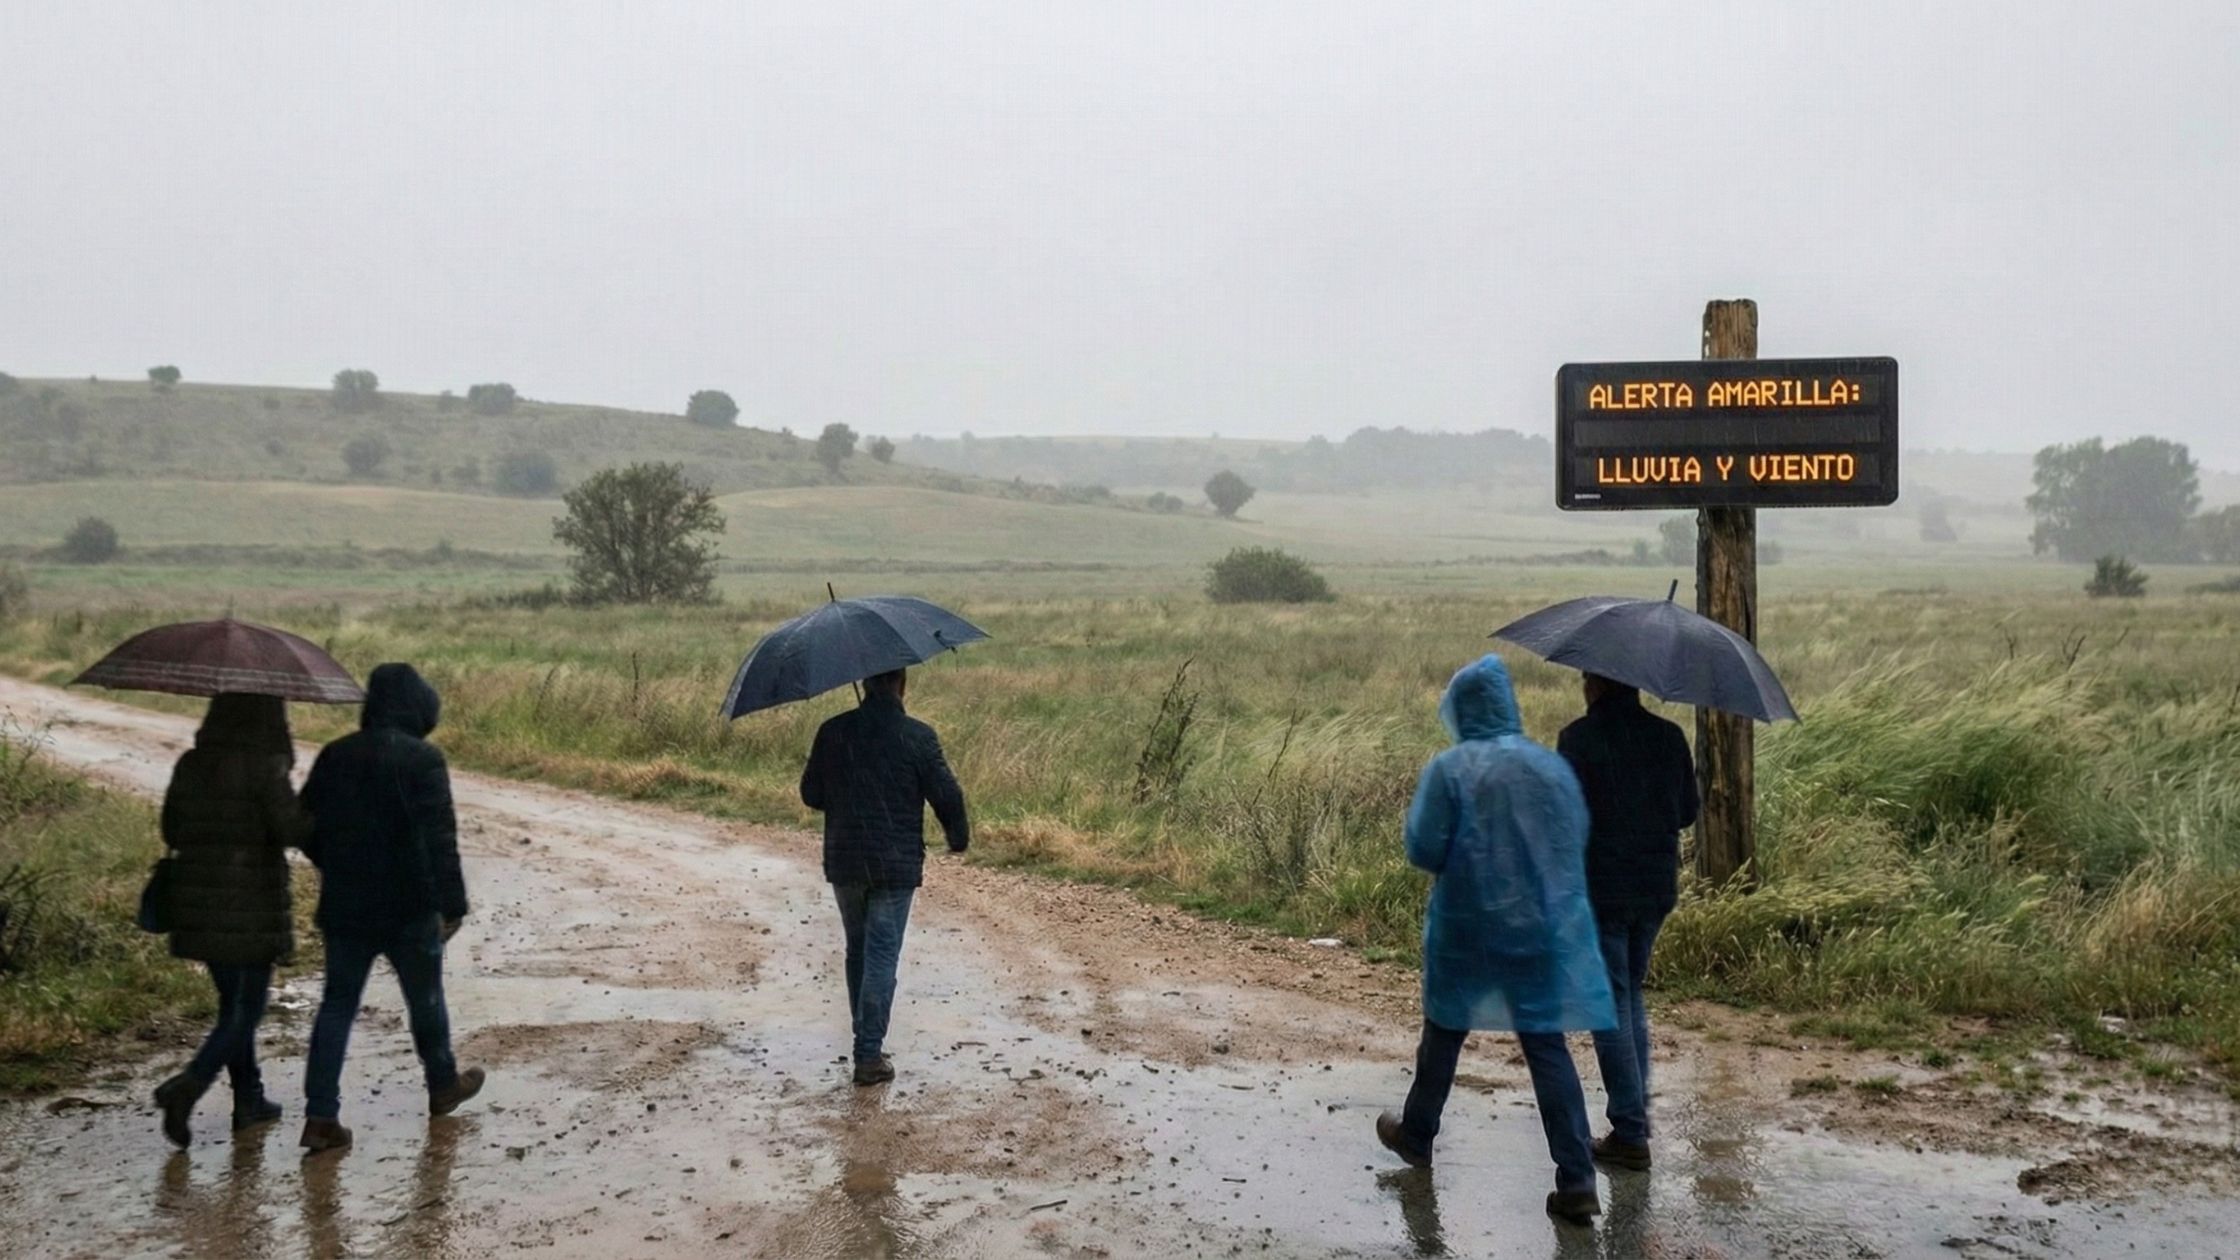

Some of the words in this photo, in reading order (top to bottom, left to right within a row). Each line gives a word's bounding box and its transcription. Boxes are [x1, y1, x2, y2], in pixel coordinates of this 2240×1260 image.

[1589, 382, 1693, 409] ALERTA
[1707, 380, 1860, 407] AMARILLA:
[1598, 456, 1701, 483] LLUVIA
[1716, 455, 1734, 481] Y
[1749, 454, 1855, 481] VIENTO
